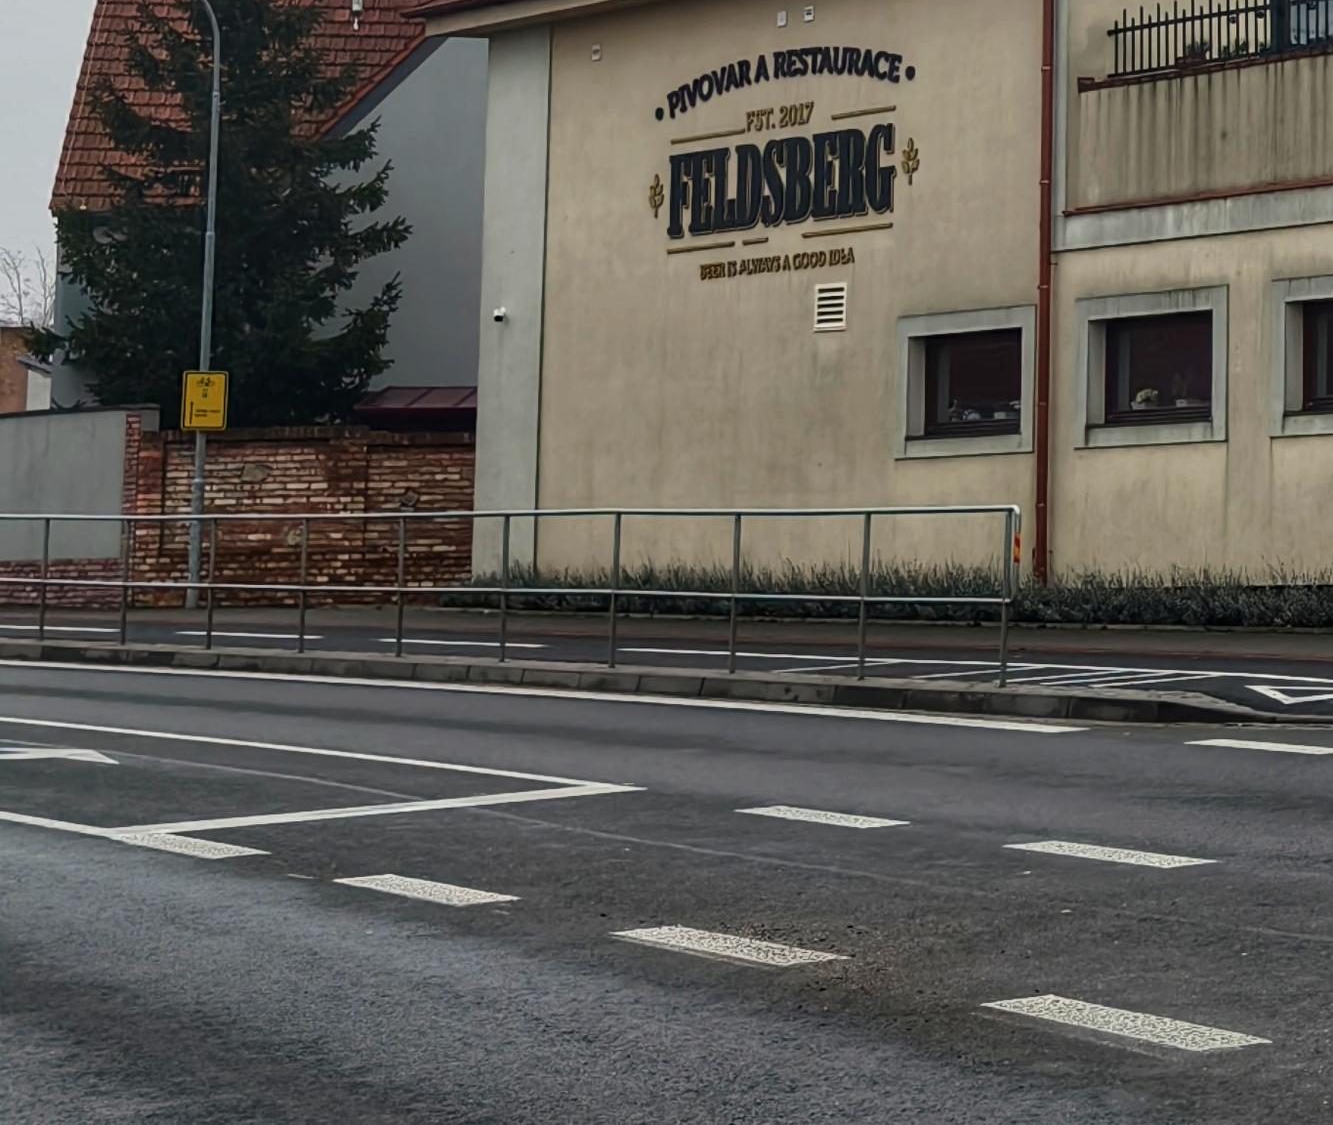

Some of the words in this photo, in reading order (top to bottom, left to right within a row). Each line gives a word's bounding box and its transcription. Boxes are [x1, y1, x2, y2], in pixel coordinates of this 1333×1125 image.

[667, 59, 752, 119] PIVOVAR
[754, 54, 769, 84] A
[772, 46, 903, 83] RESTAURACE
[779, 100, 814, 129] 2017
[667, 123, 897, 239] FELDSBERG
[727, 260, 738, 278] IS
[738, 255, 782, 276] ALWAYS
[782, 254, 792, 271] A
[793, 250, 827, 271] GOOD
[828, 246, 856, 267] IDEA
